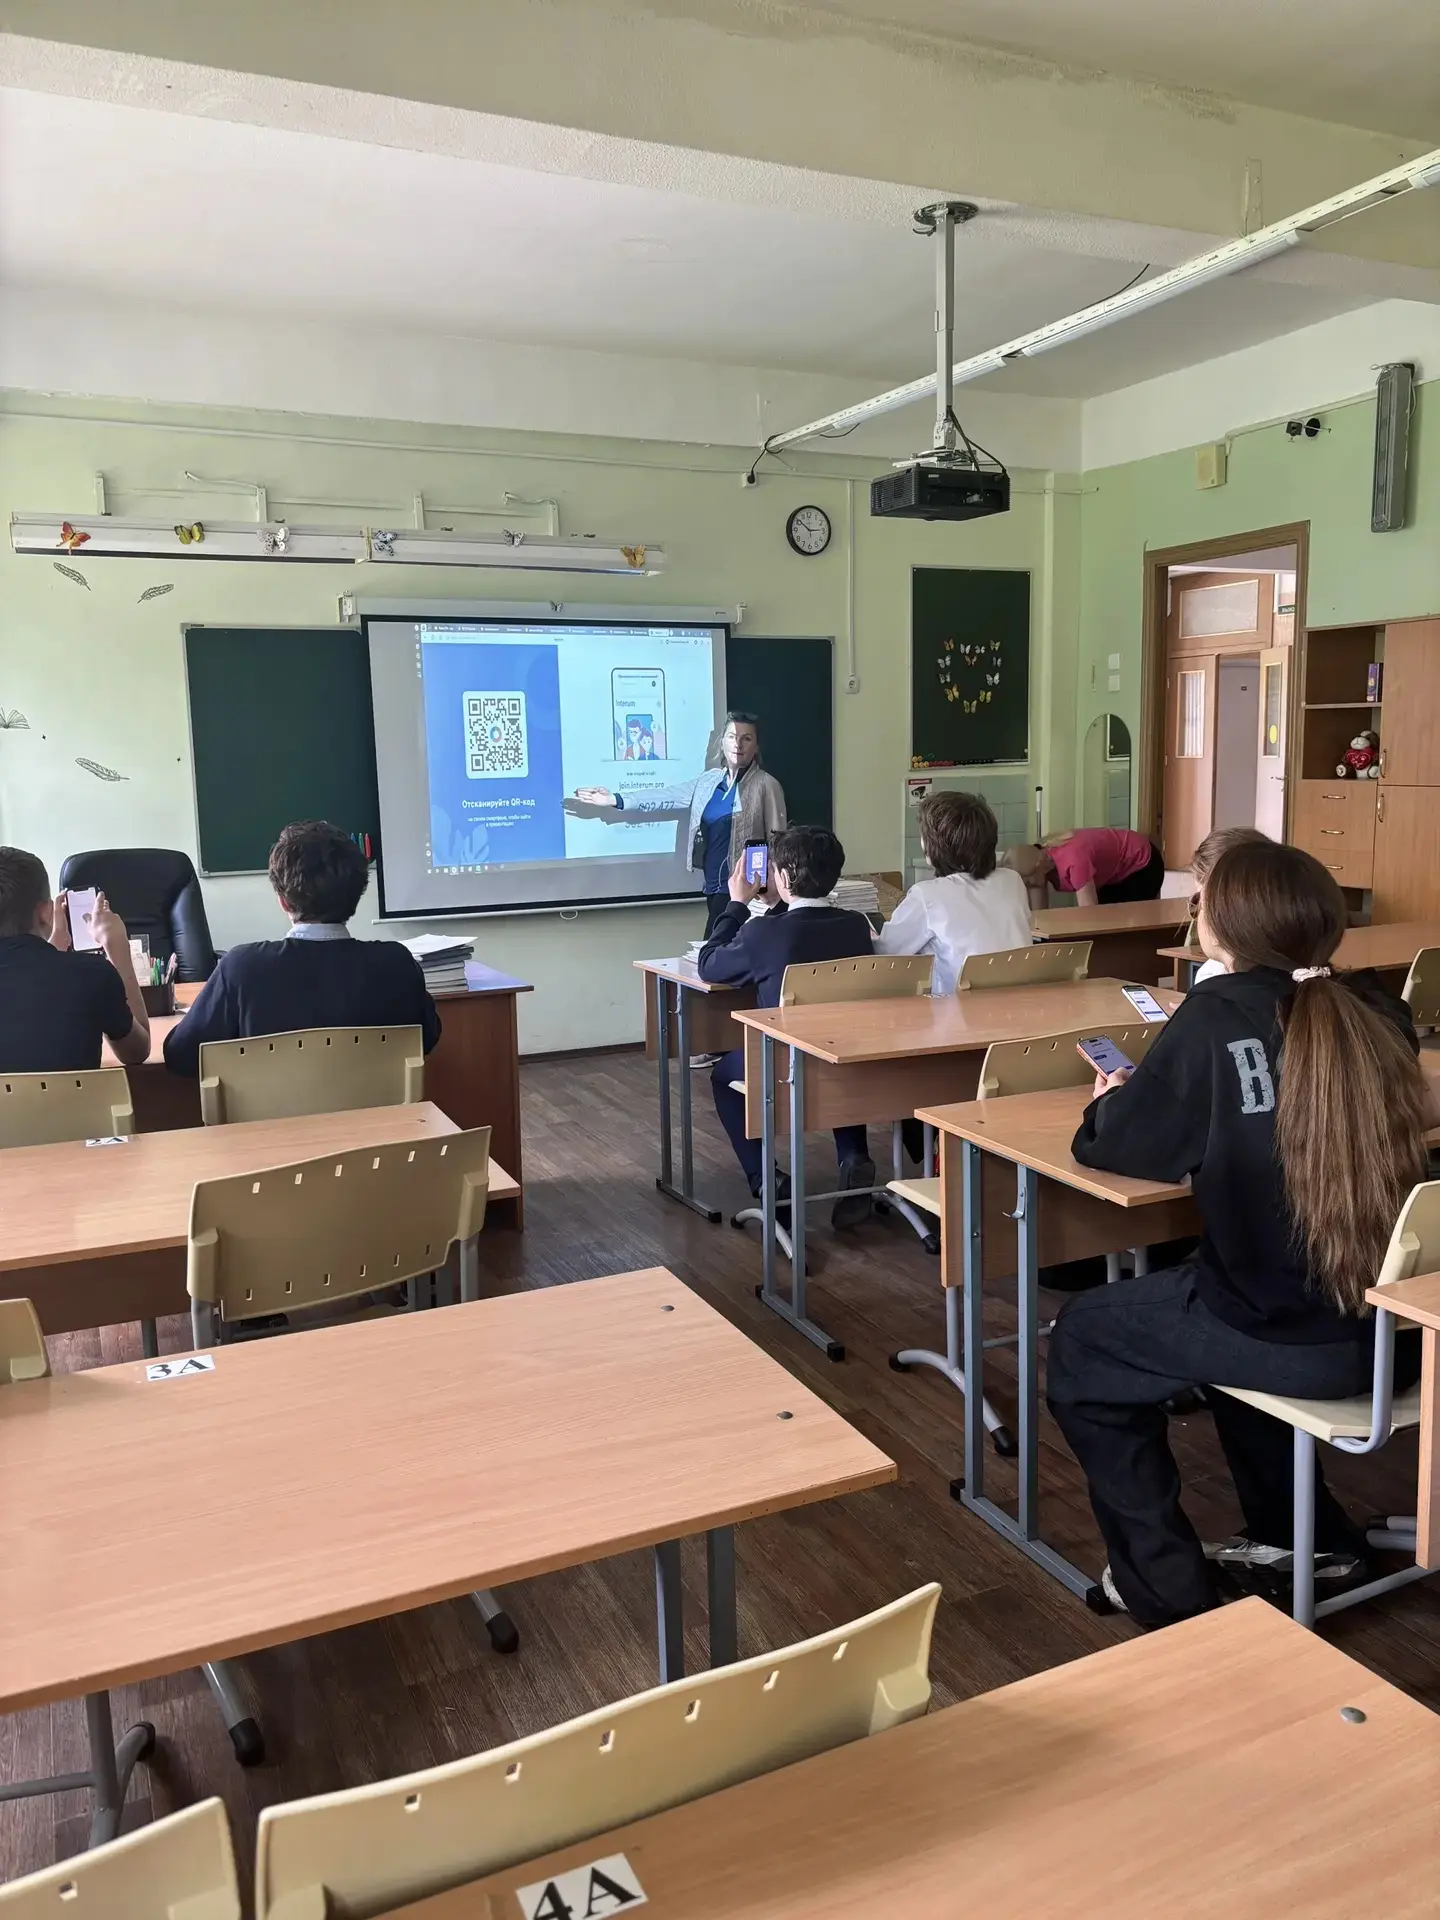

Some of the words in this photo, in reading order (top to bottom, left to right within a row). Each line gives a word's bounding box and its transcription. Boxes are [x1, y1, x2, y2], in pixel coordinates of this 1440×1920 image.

[462, 799, 510, 808] Отсканируйте
[511, 798, 536, 807] QR-код
[1226, 1038, 1275, 1114] B
